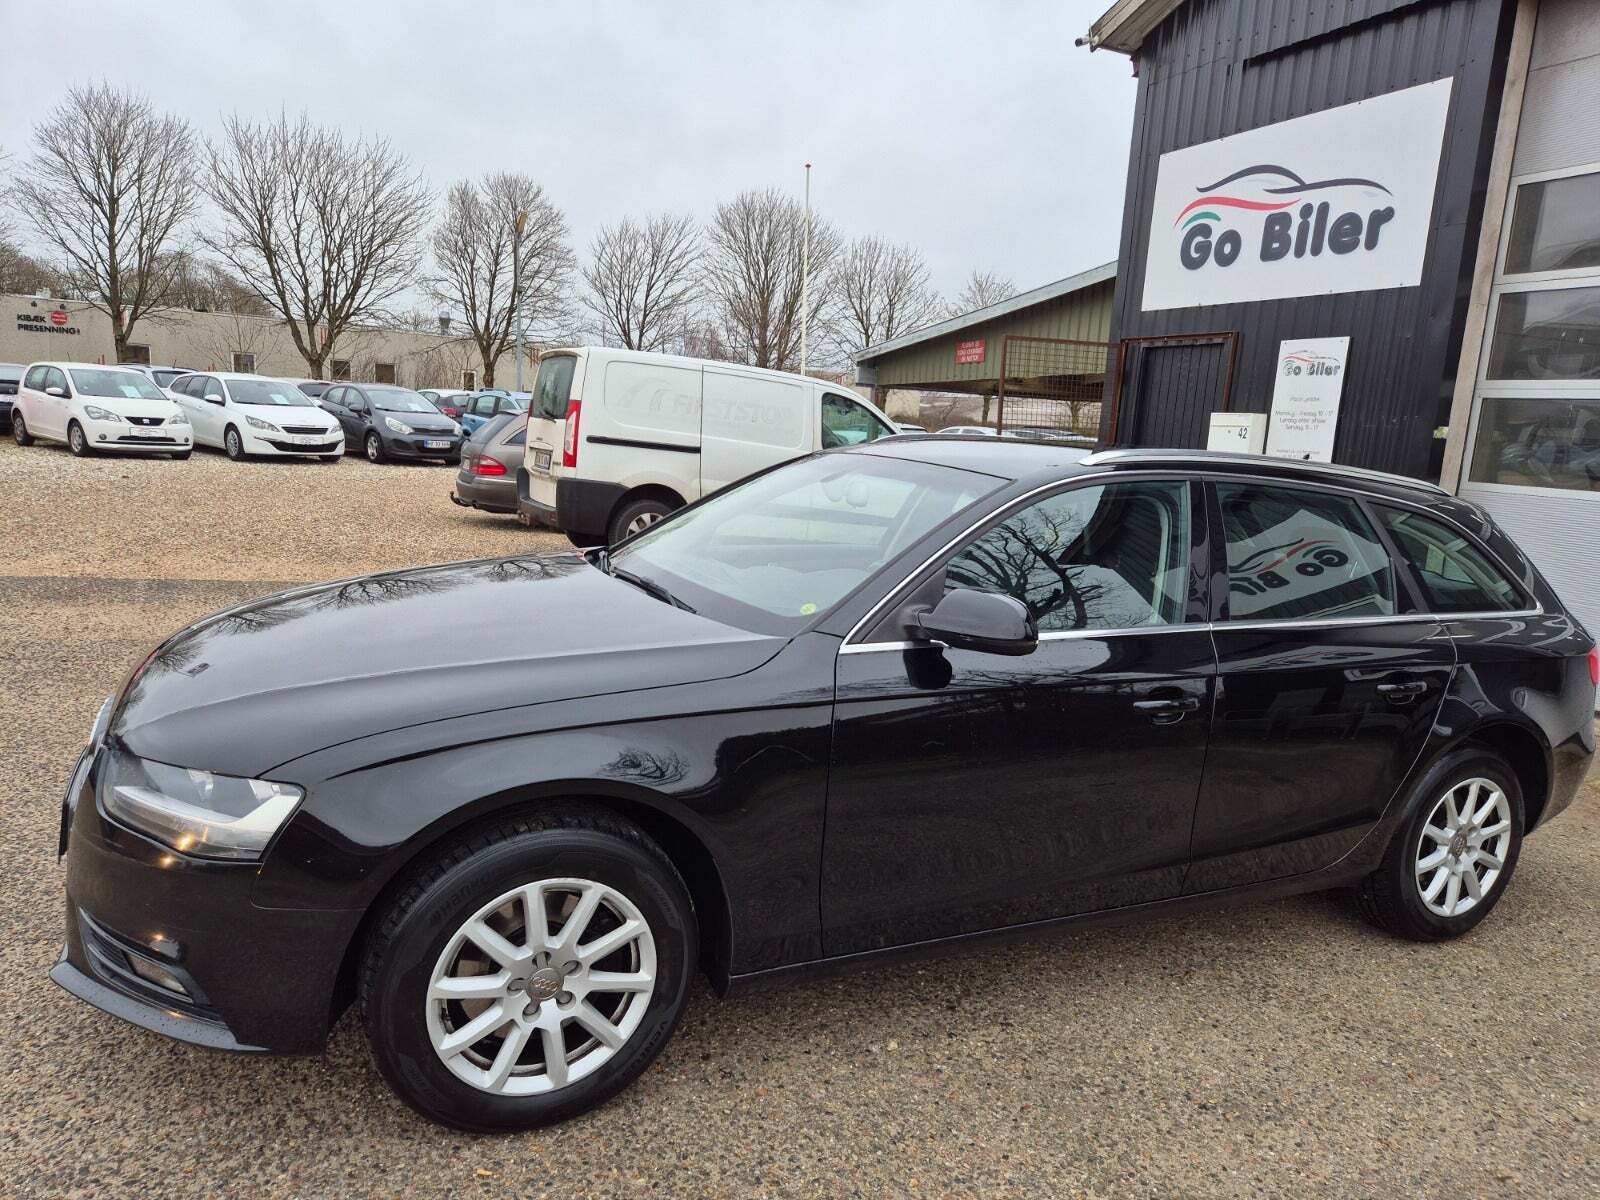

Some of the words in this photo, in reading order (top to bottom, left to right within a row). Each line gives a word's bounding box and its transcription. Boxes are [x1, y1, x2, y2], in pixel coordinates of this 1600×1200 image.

[1180, 222, 1242, 270] Go
[1260, 201, 1395, 262] Biler
[17, 314, 46, 322] KIBÆK
[1238, 427, 1248, 439] 42
